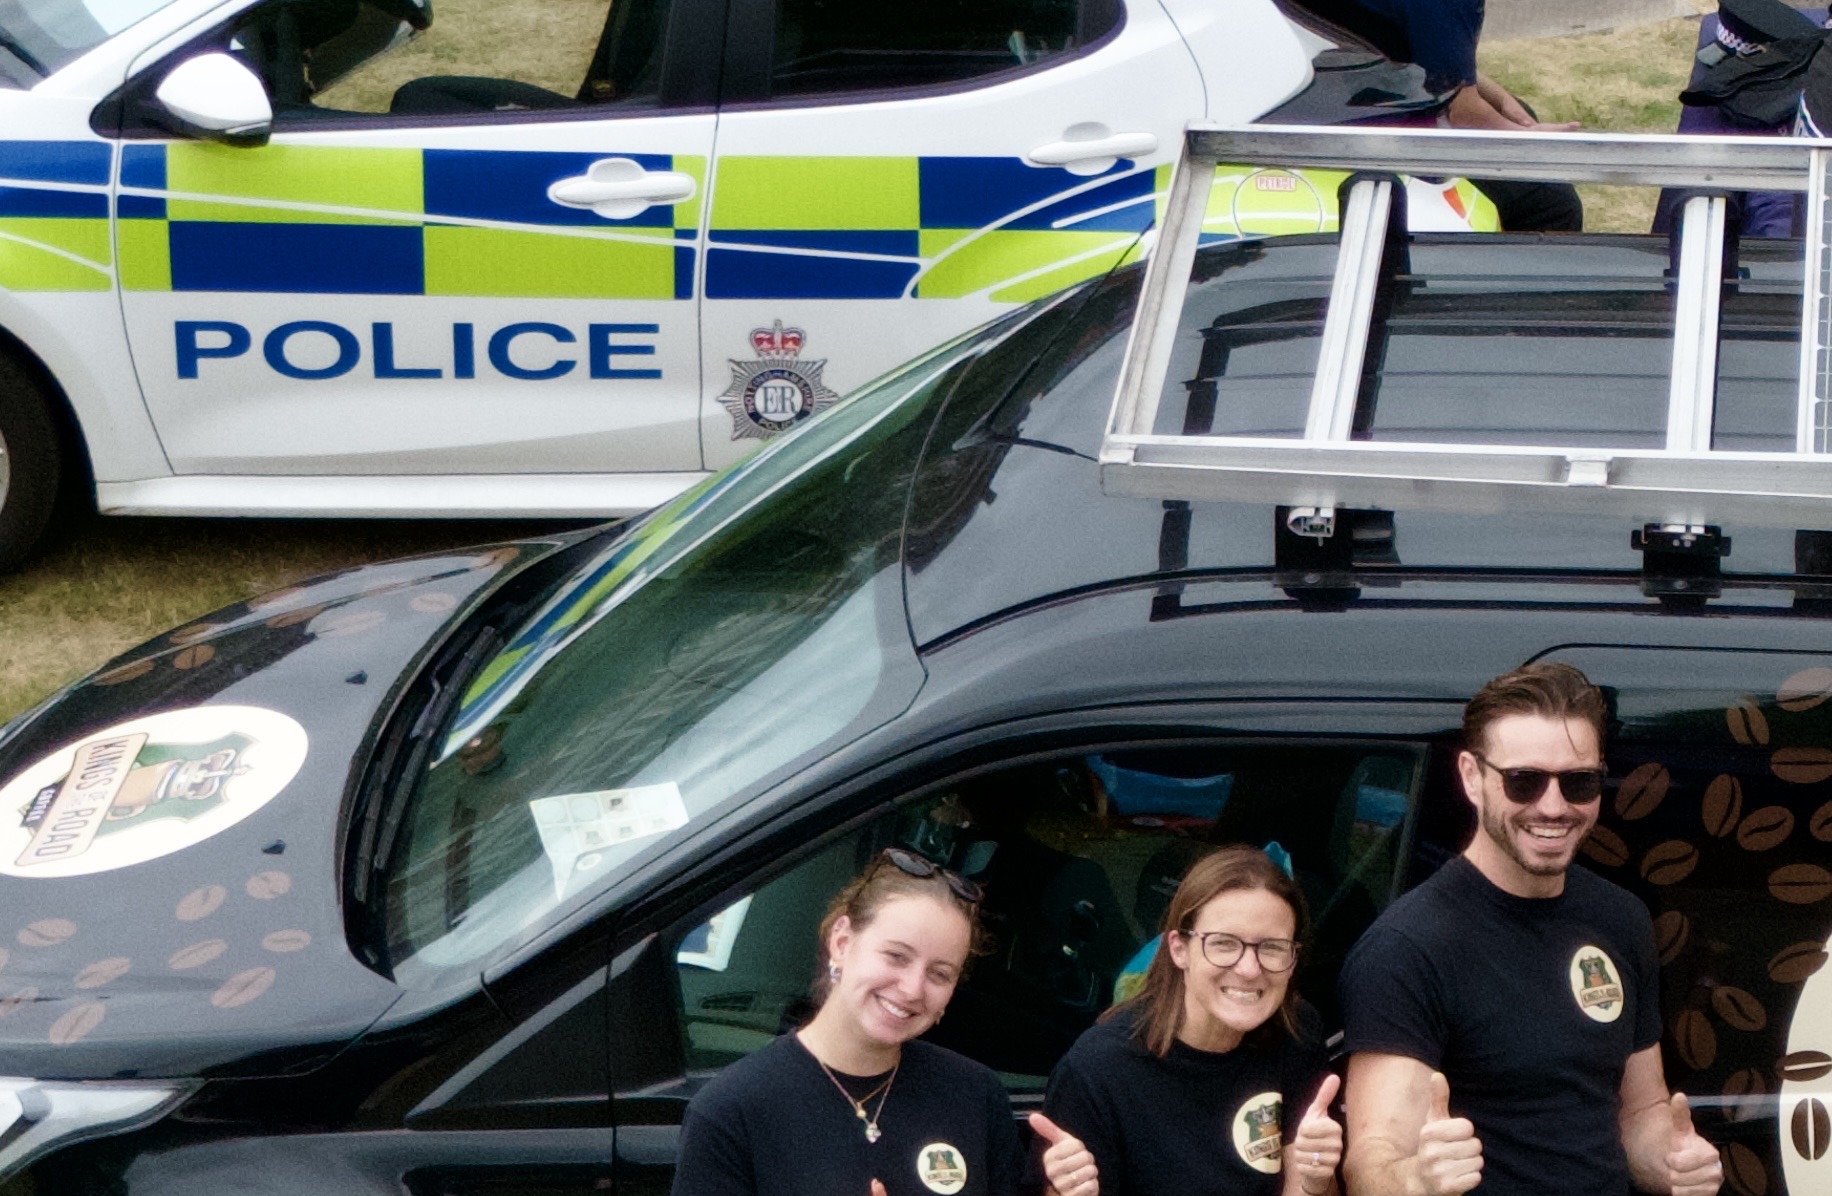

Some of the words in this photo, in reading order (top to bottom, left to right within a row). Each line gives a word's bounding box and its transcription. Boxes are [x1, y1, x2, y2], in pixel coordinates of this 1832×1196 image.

[1258, 176, 1293, 190] PETROL
[174, 320, 663, 380] POLICE
[75, 739, 129, 790] KINGS
[35, 807, 97, 857] ROAD
